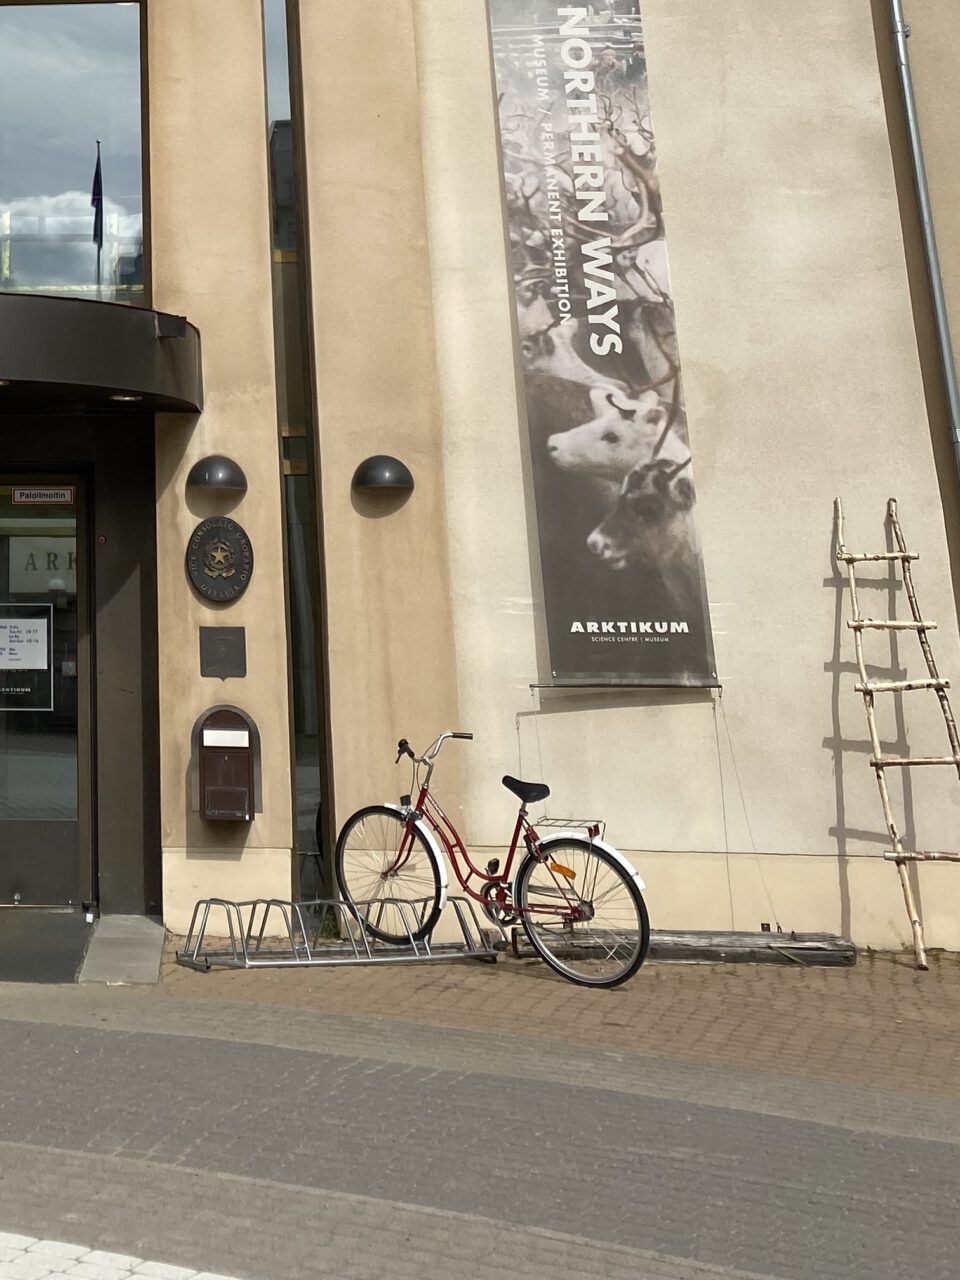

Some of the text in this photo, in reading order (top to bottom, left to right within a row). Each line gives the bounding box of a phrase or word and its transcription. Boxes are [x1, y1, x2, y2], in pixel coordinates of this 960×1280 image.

[532, 34, 550, 101] MUSEUM
[540, 123, 562, 221] PERMANENT
[557, 7, 623, 356] NORTHERN WAYS
[551, 228, 572, 326] EXHIBITION
[19, 491, 66, 500] Paloilmoitin
[570, 621, 689, 633] ARKTIKUM
